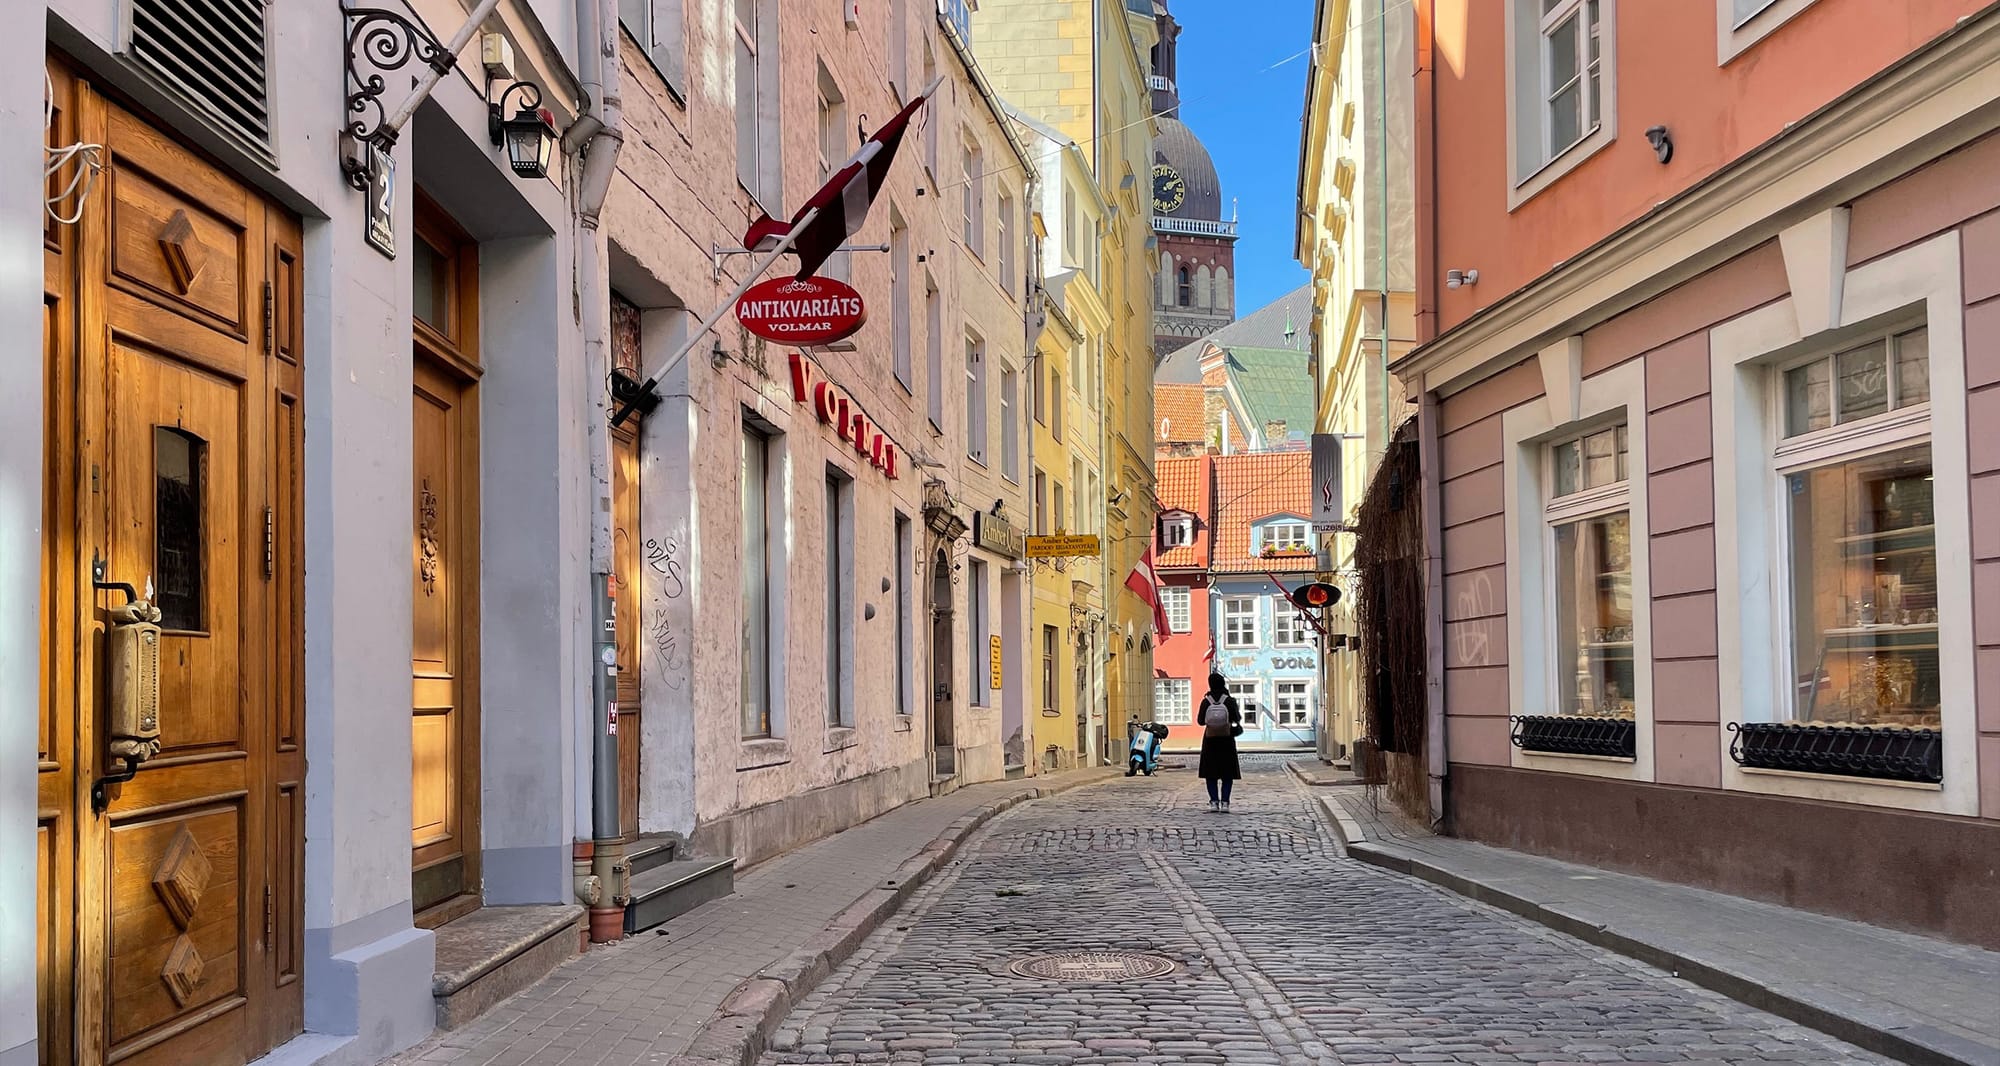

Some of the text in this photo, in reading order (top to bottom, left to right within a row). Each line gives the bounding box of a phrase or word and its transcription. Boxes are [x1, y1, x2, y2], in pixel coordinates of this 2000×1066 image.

[379, 173, 390, 215] 2
[740, 295, 860, 319] ANTIKVARIĀTS
[768, 322, 831, 332] VOLMAR
[788, 354, 899, 480] VOLMAR
[983, 517, 1006, 546] Amber
